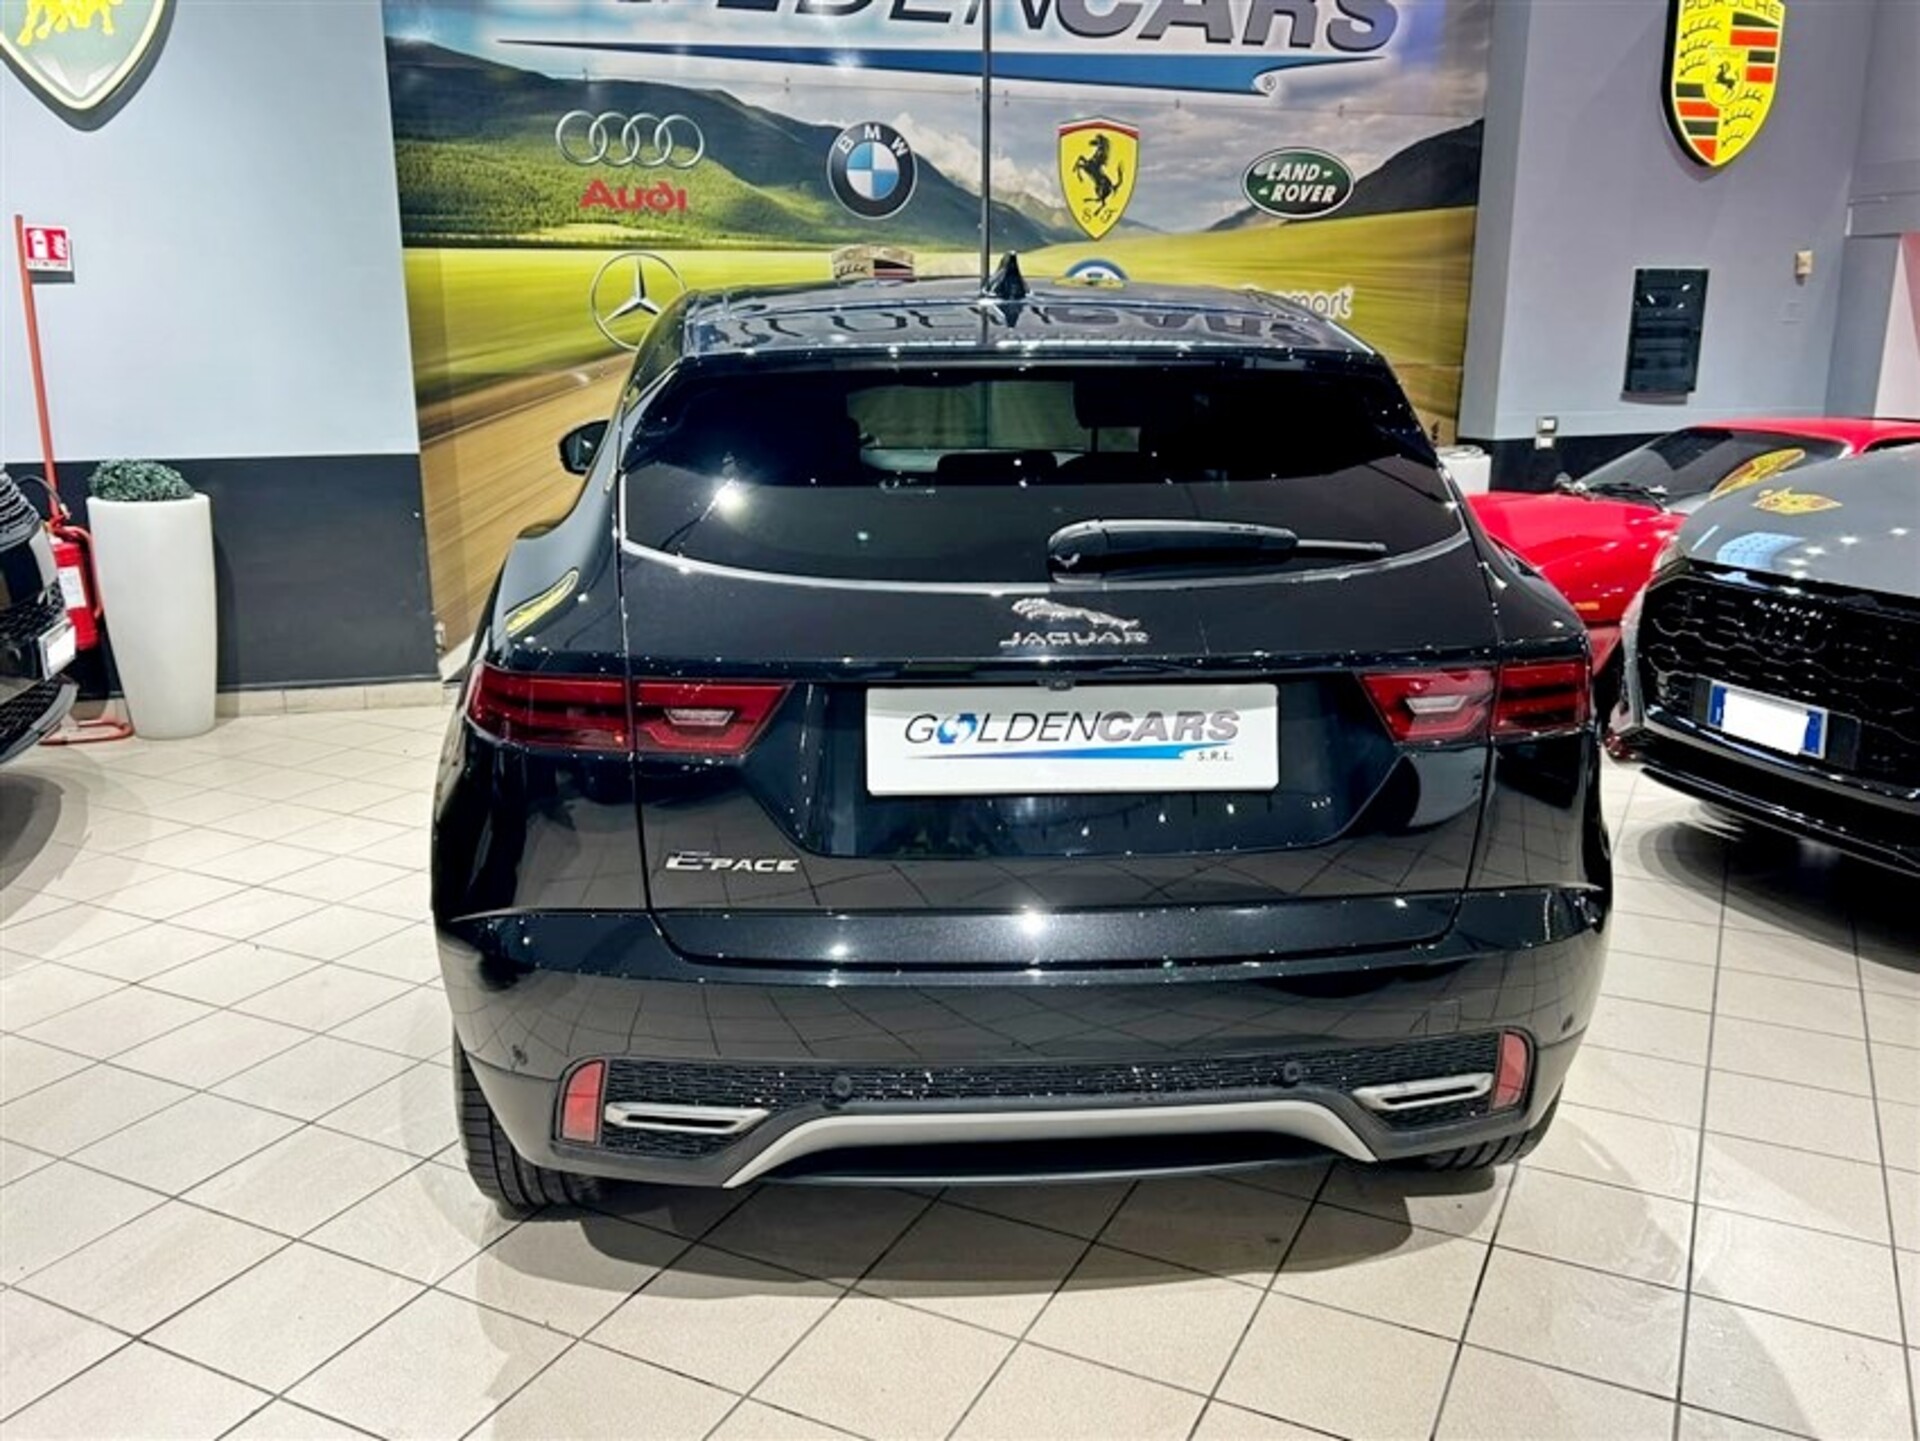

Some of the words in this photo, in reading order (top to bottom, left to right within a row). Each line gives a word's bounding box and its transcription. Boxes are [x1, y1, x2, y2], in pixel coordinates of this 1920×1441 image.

[837, 124, 909, 157] BMW
[1266, 162, 1321, 182] LAND
[578, 179, 687, 213] Audi
[1271, 183, 1337, 203] ROVER
[999, 631, 1150, 647] JAGUAR
[904, 709, 1241, 745] GOLDENCARS
